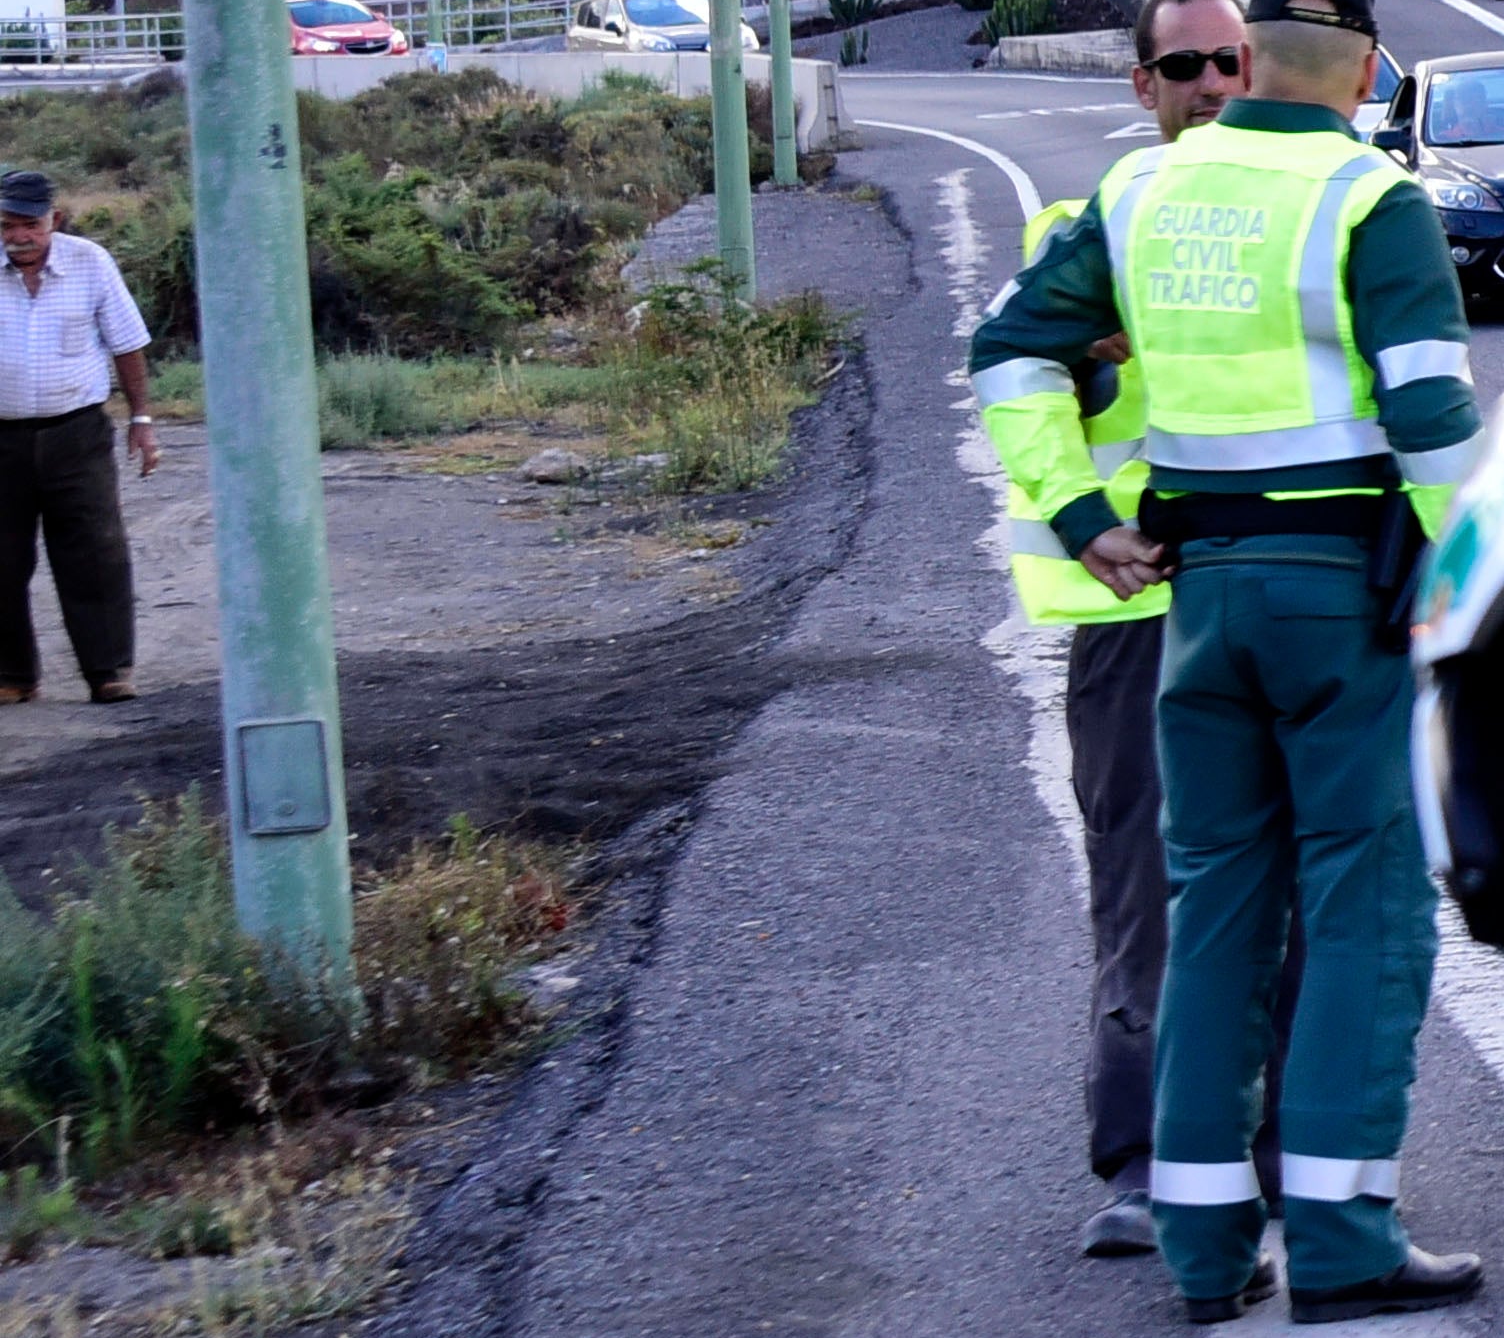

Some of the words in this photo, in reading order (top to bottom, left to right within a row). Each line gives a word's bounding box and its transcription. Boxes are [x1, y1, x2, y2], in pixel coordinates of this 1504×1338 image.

[1153, 204, 1266, 239] GUARDIA
[1171, 238, 1240, 273] CIVIL
[1148, 271, 1260, 310] TRAFICO
